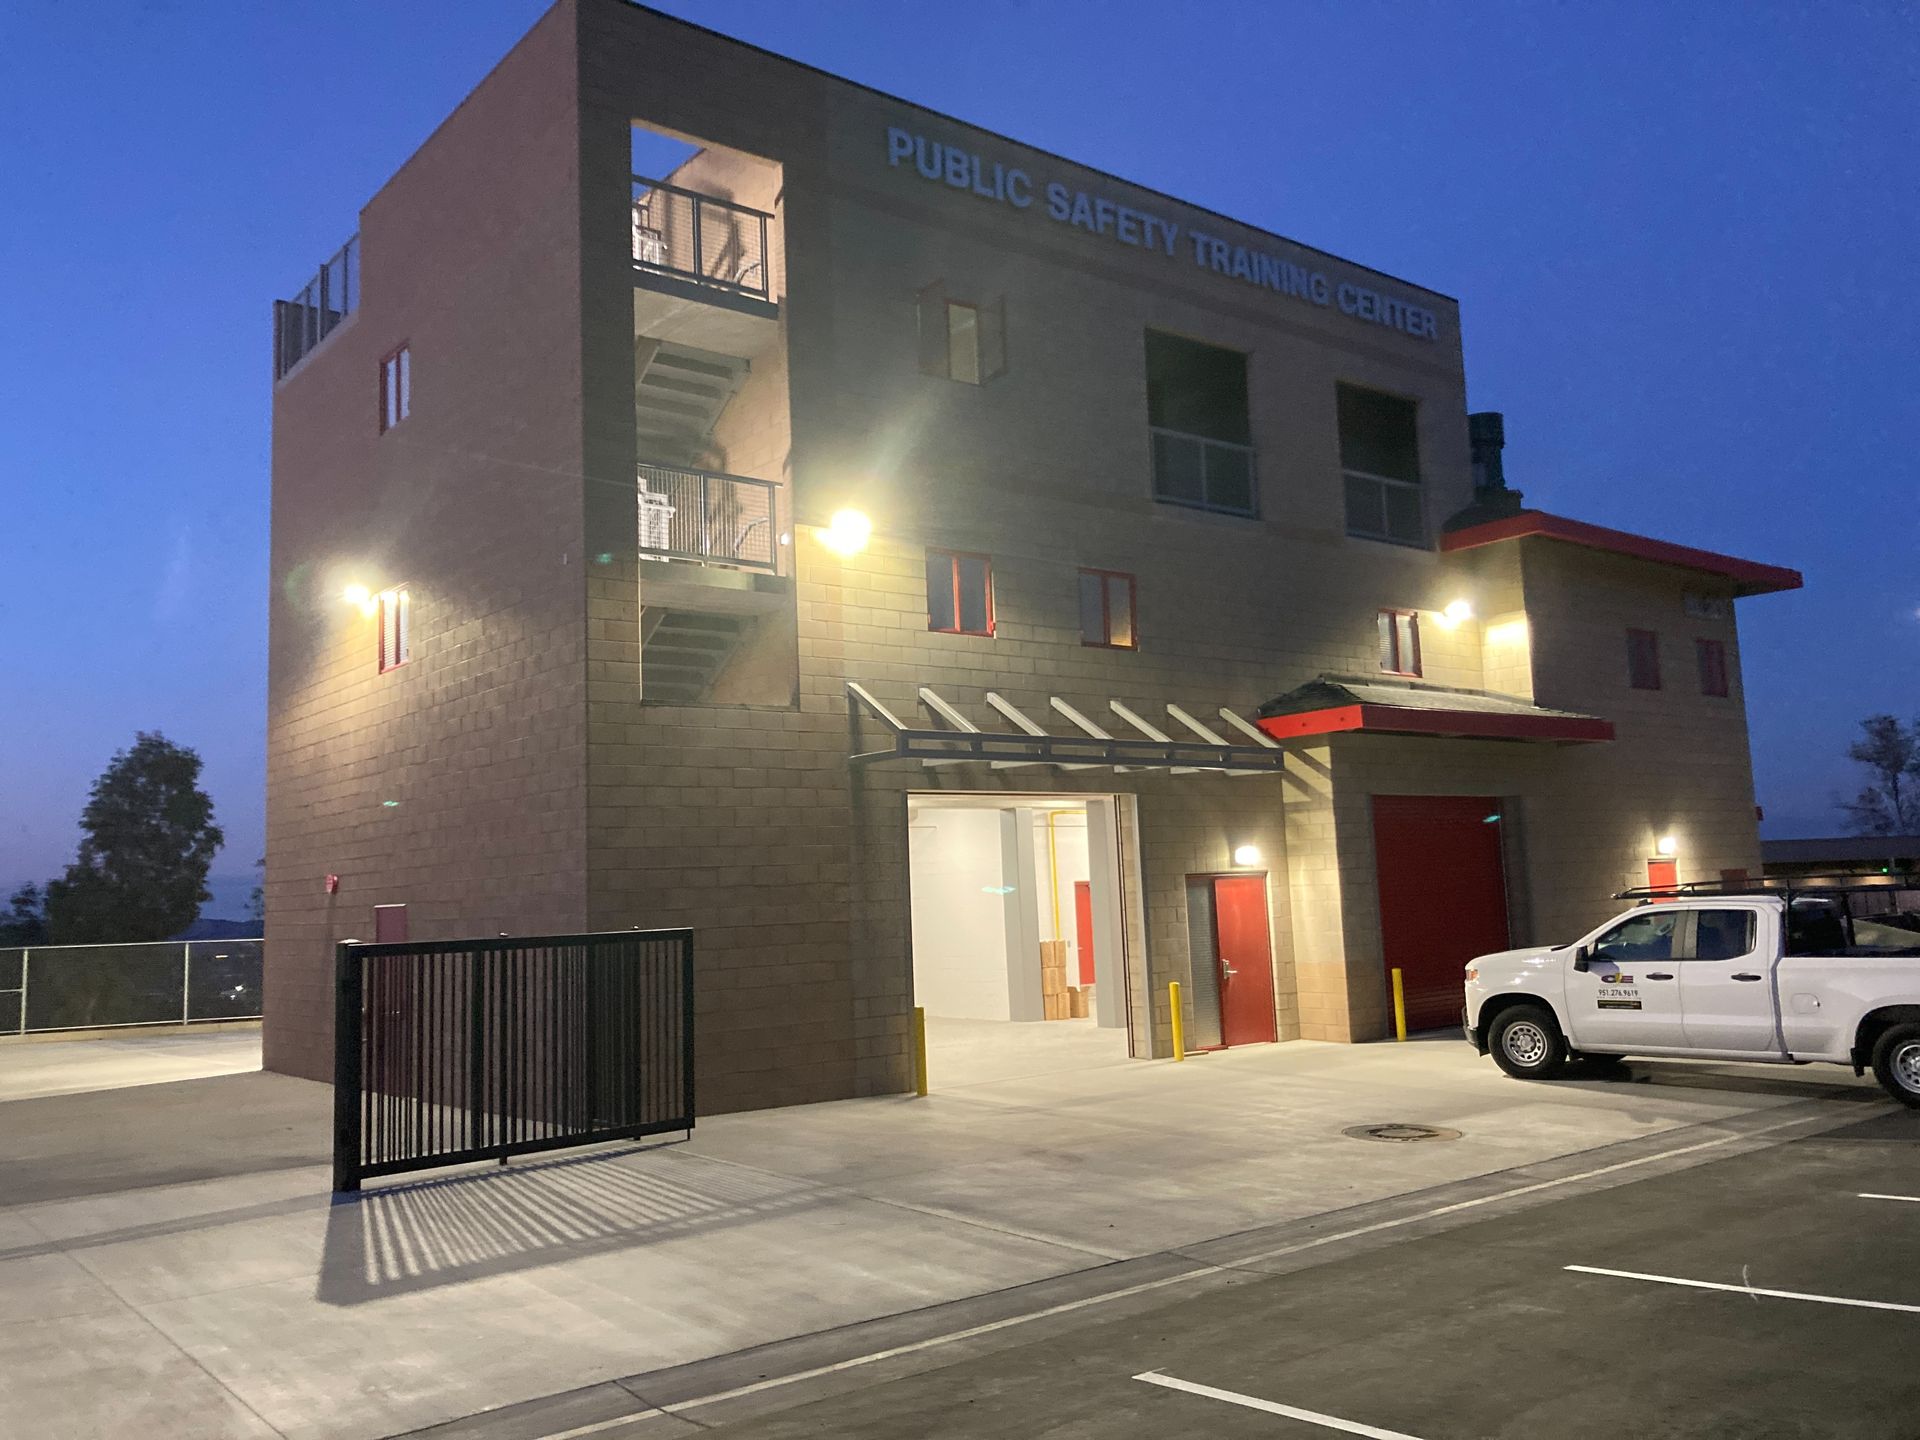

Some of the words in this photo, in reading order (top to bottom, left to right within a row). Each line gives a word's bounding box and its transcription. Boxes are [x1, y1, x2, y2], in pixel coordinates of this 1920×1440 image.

[888, 128, 1033, 208] PUBLIC
[1048, 182, 1178, 257] SAFETY
[1189, 231, 1329, 305] TRAINING
[1338, 284, 1437, 339] CENTER
